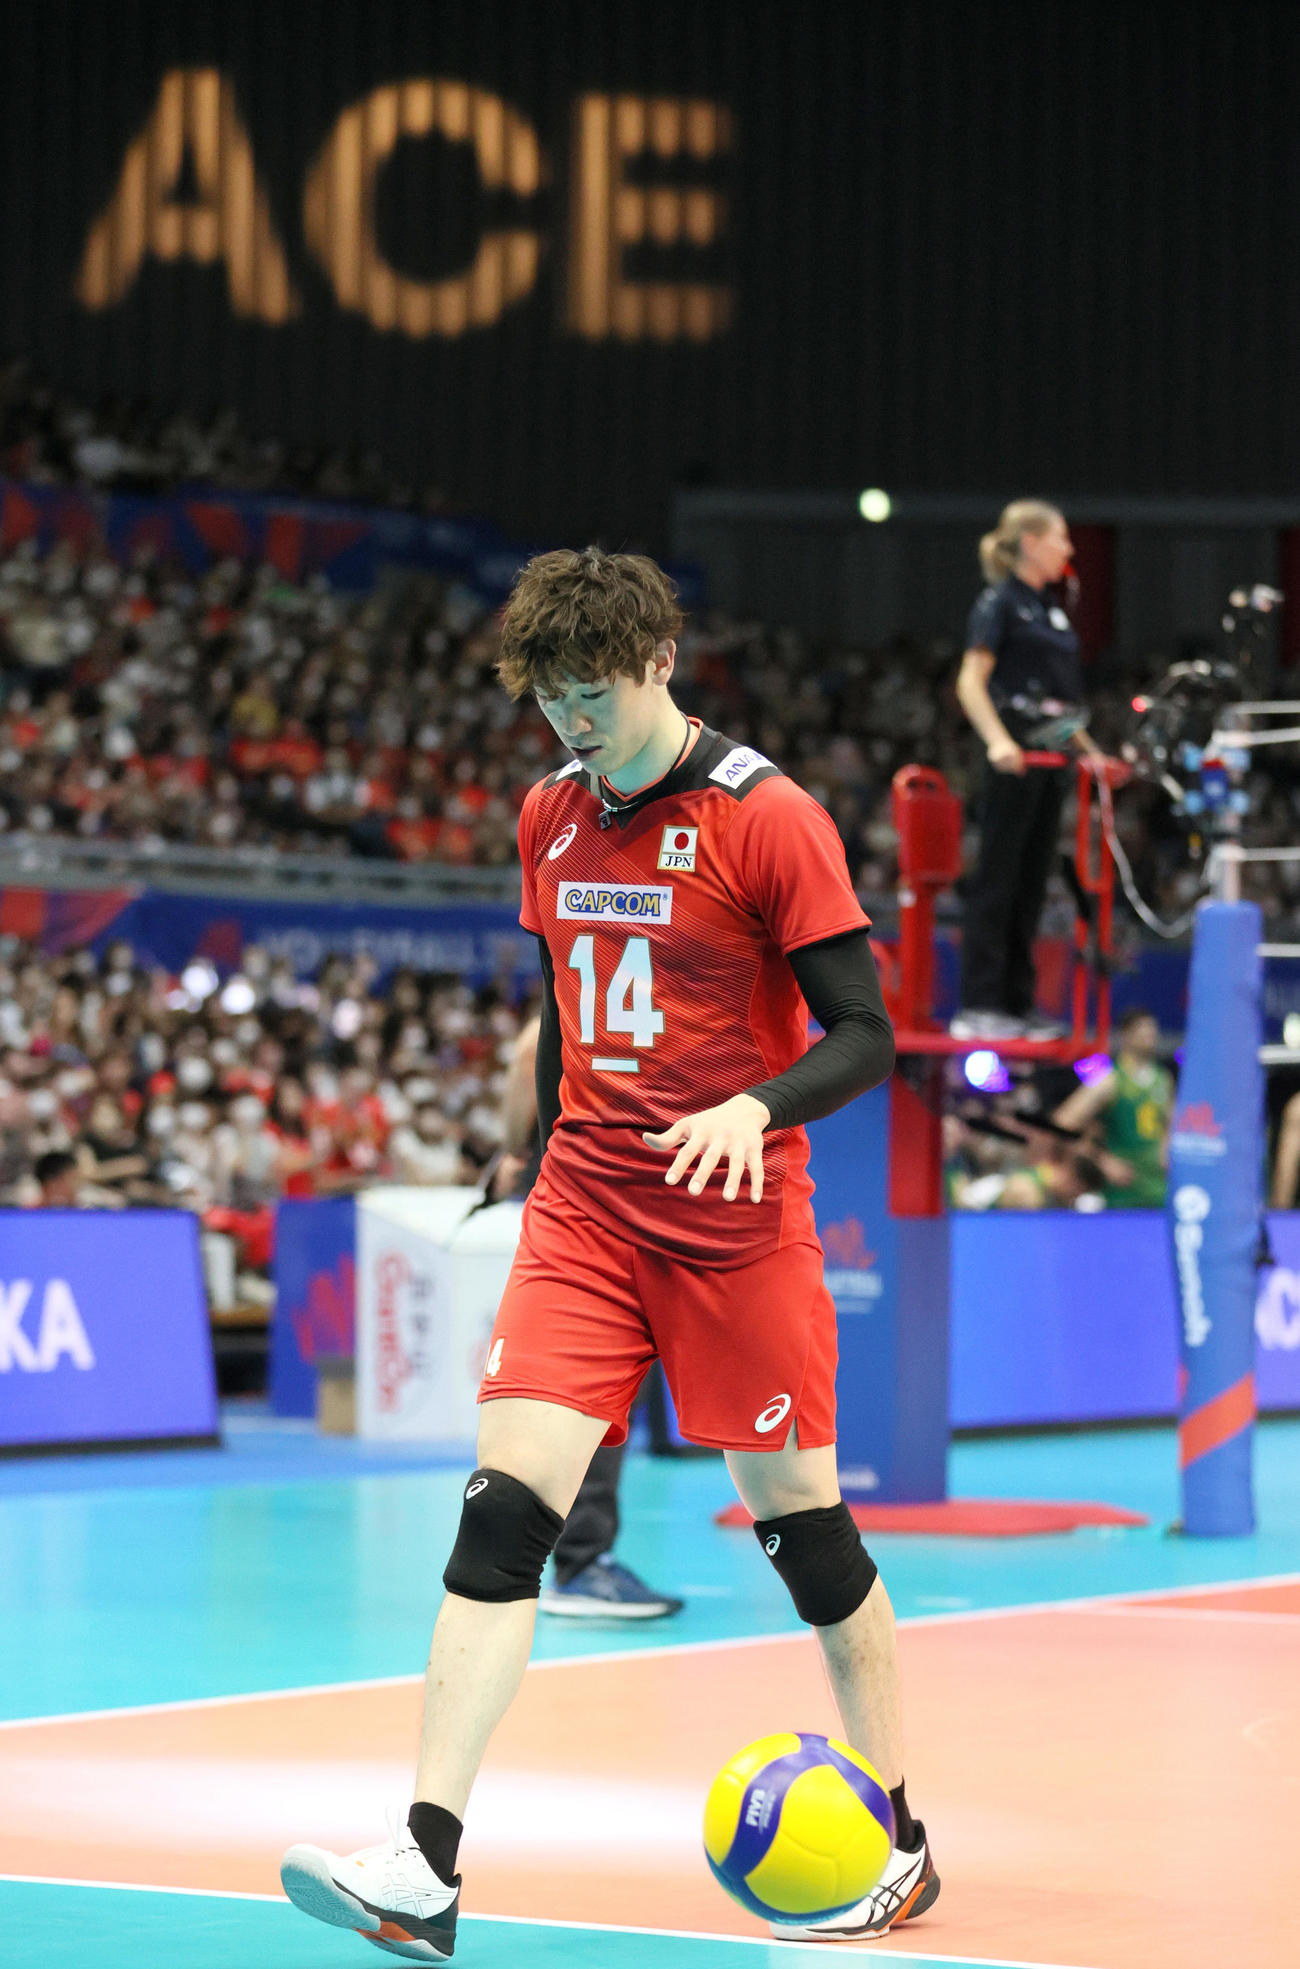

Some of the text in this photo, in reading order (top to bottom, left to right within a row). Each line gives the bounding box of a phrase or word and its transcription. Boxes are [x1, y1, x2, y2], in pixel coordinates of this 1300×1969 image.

[78, 66, 732, 340] ACE
[665, 855, 693, 868] JPN
[565, 889, 661, 917] CAPCOM
[568, 933, 666, 1049] 14
